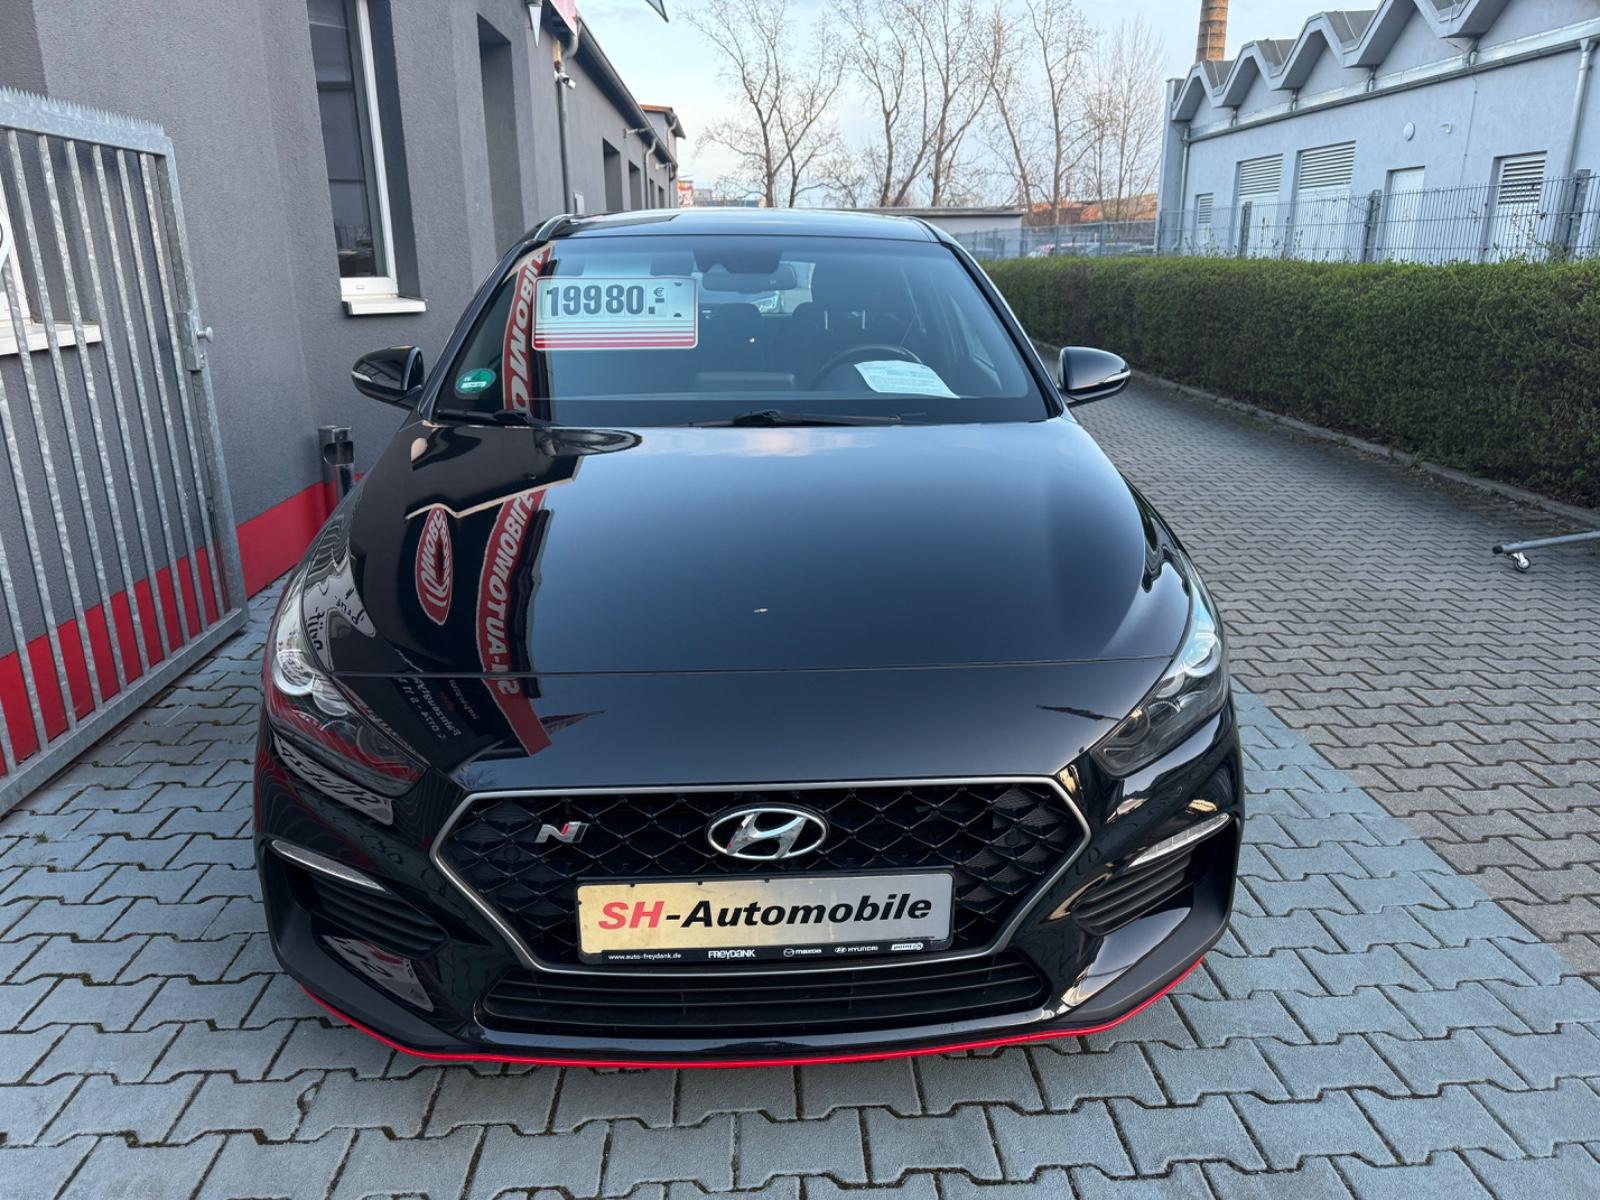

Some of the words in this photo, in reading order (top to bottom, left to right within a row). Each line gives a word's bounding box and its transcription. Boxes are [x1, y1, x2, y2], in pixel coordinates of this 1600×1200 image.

[598, 893, 932, 930] SH-Automobile
[608, 952, 682, 961] www.auto-freydank.de
[848, 945, 879, 953] HYUNDAI
